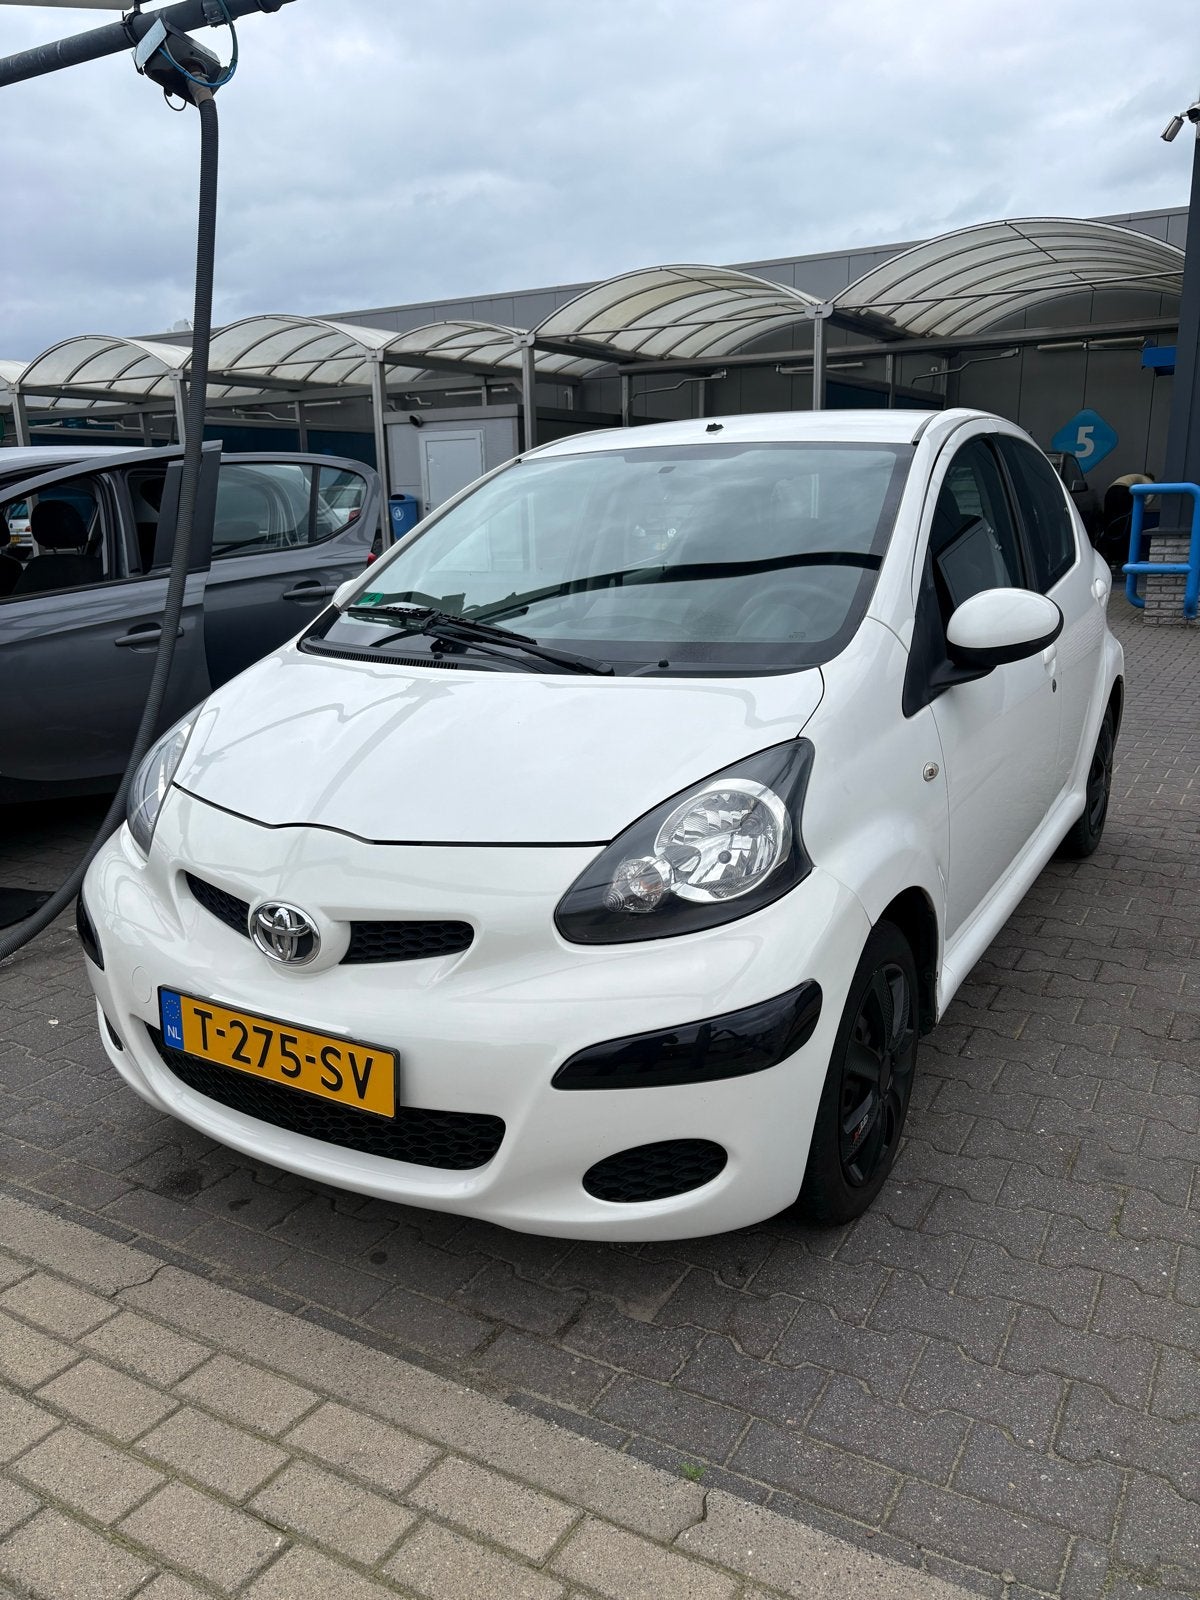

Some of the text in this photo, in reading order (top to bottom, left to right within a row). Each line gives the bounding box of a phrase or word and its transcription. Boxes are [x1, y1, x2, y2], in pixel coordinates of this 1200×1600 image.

[1075, 426, 1095, 458] 5
[167, 1024, 182, 1041] NL
[193, 1007, 374, 1100] T-275-SV
